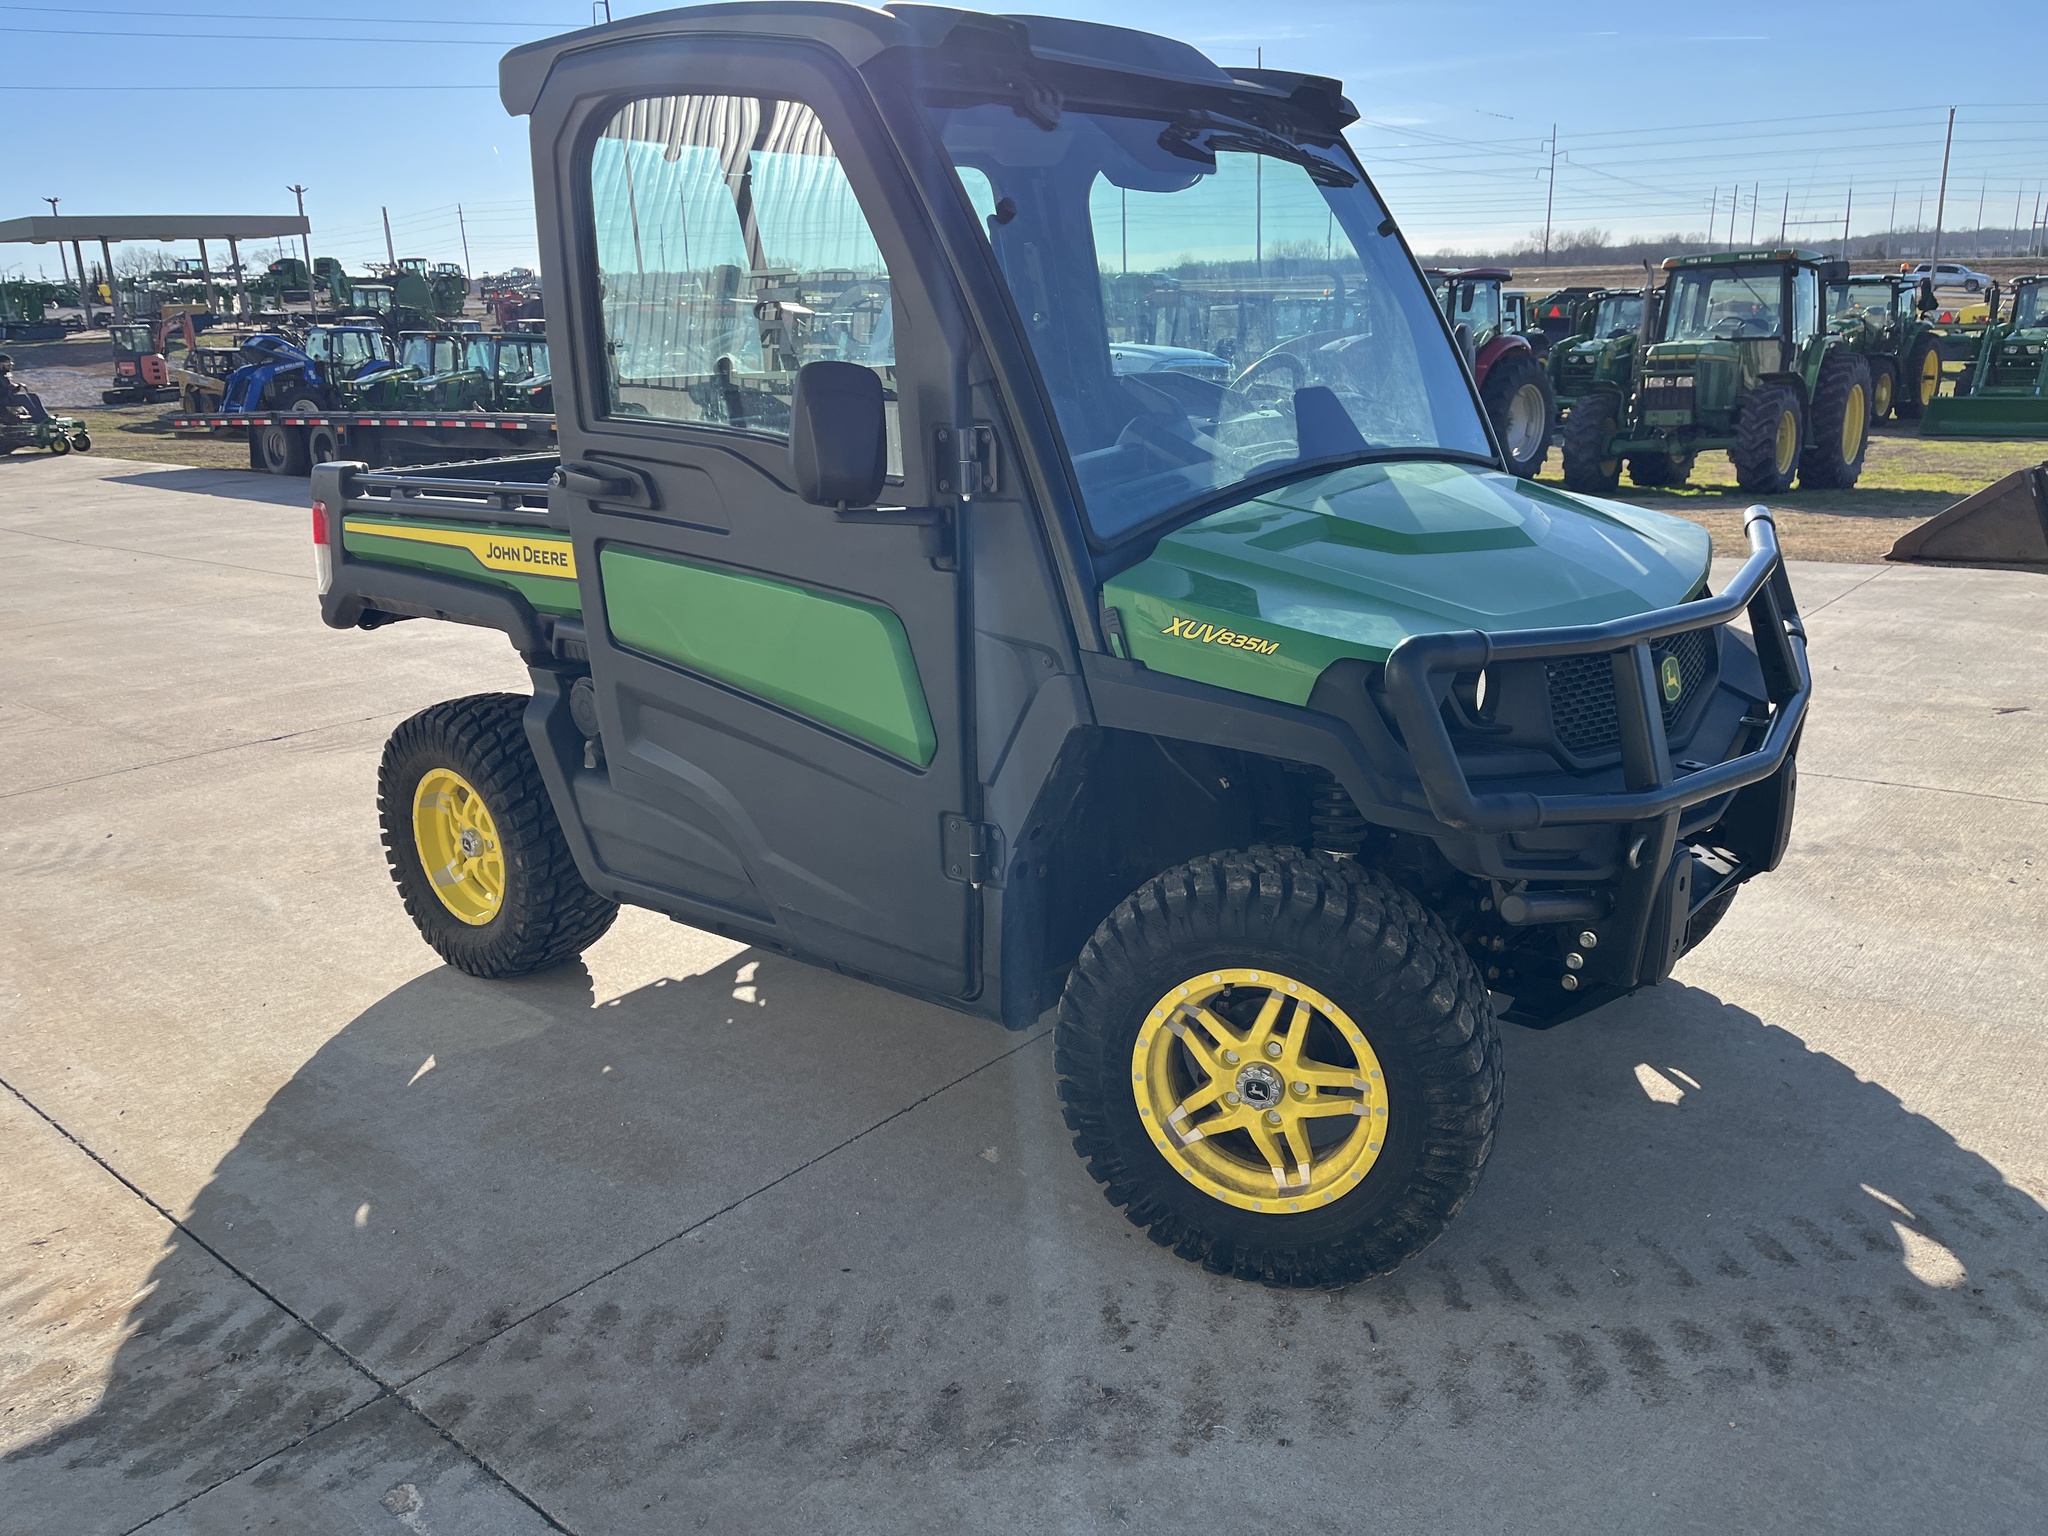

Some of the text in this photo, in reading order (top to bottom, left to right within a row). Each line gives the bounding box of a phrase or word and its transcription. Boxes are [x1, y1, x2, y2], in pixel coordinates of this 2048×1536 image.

[486, 542, 569, 567] JOHN DEERE
[1159, 615, 1281, 655] XUV835M
